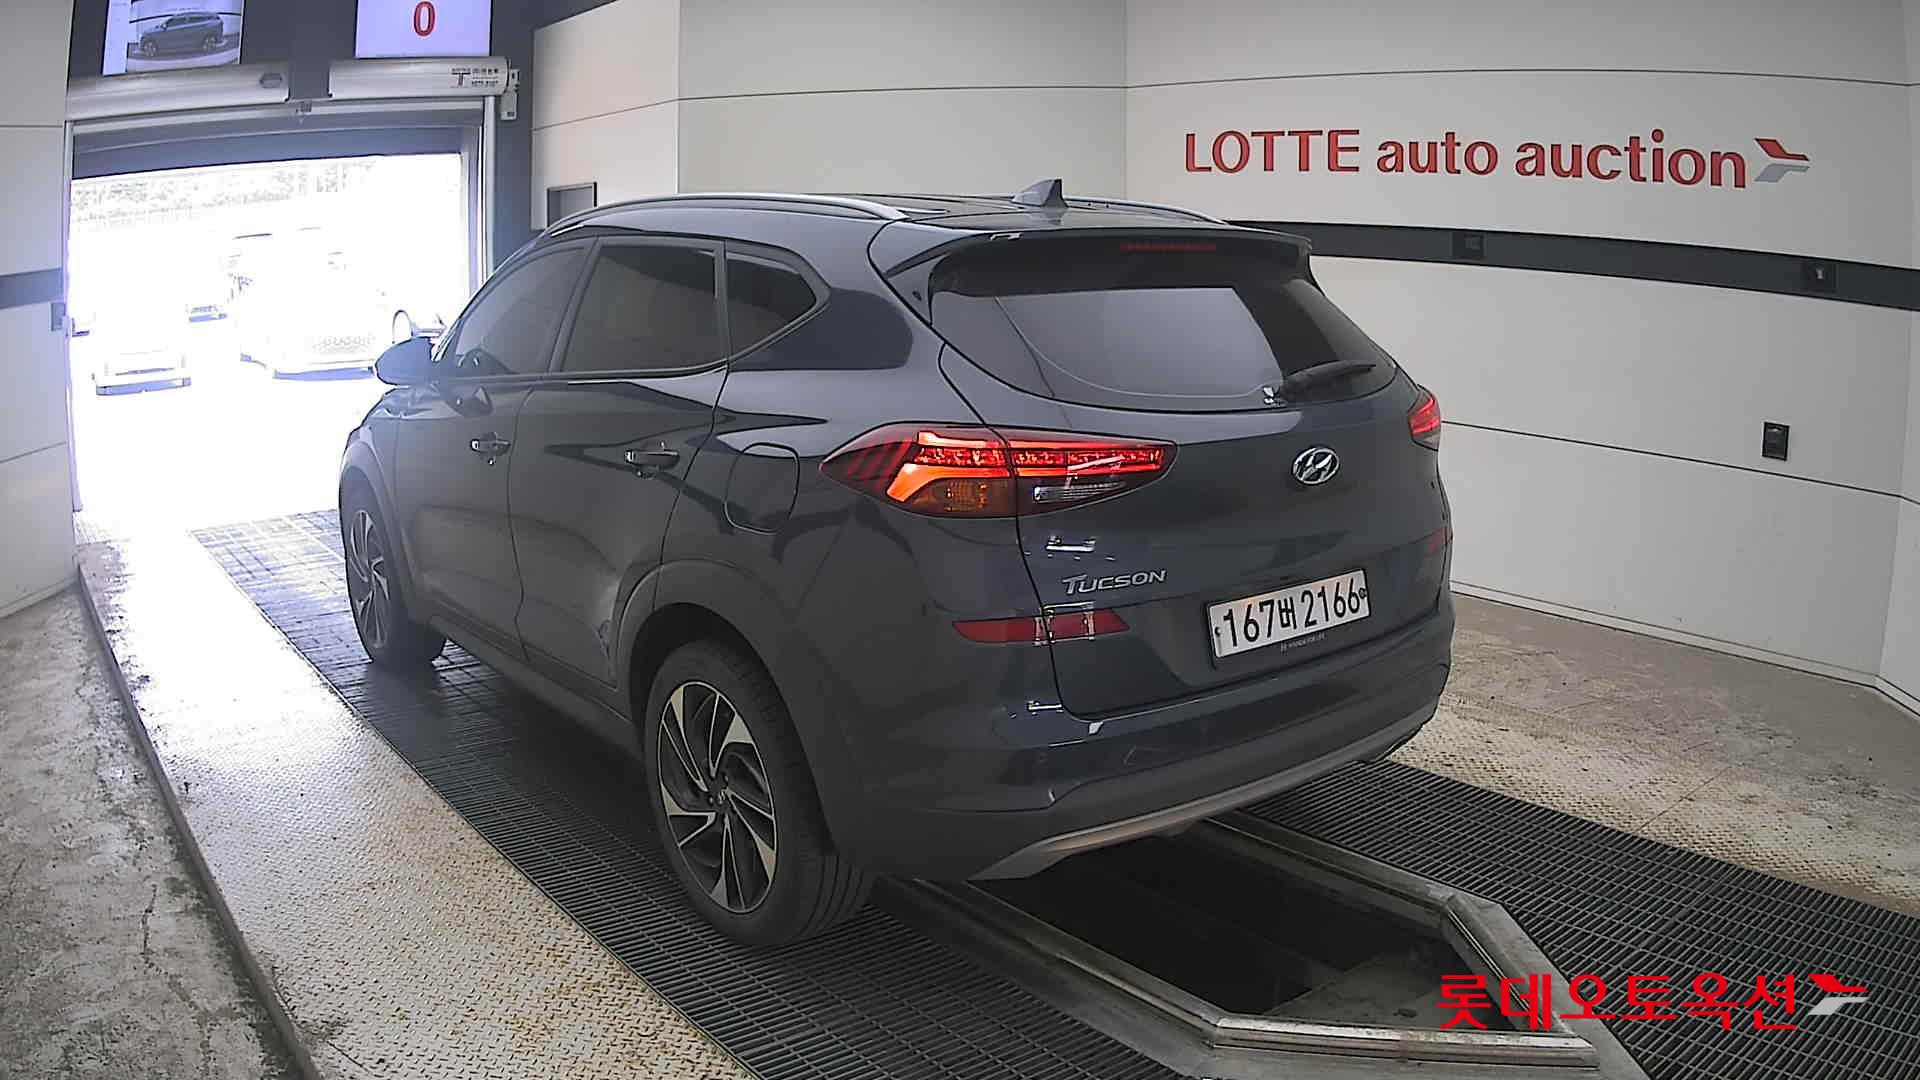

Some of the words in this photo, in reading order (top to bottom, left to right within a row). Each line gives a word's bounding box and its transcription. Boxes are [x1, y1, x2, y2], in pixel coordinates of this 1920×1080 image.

[413, 1, 435, 36] 0
[1185, 130, 1358, 174] LOTTE
[1378, 133, 1498, 176] auto
[1516, 130, 1746, 188] auction
[1062, 569, 1166, 594] TUCSON
